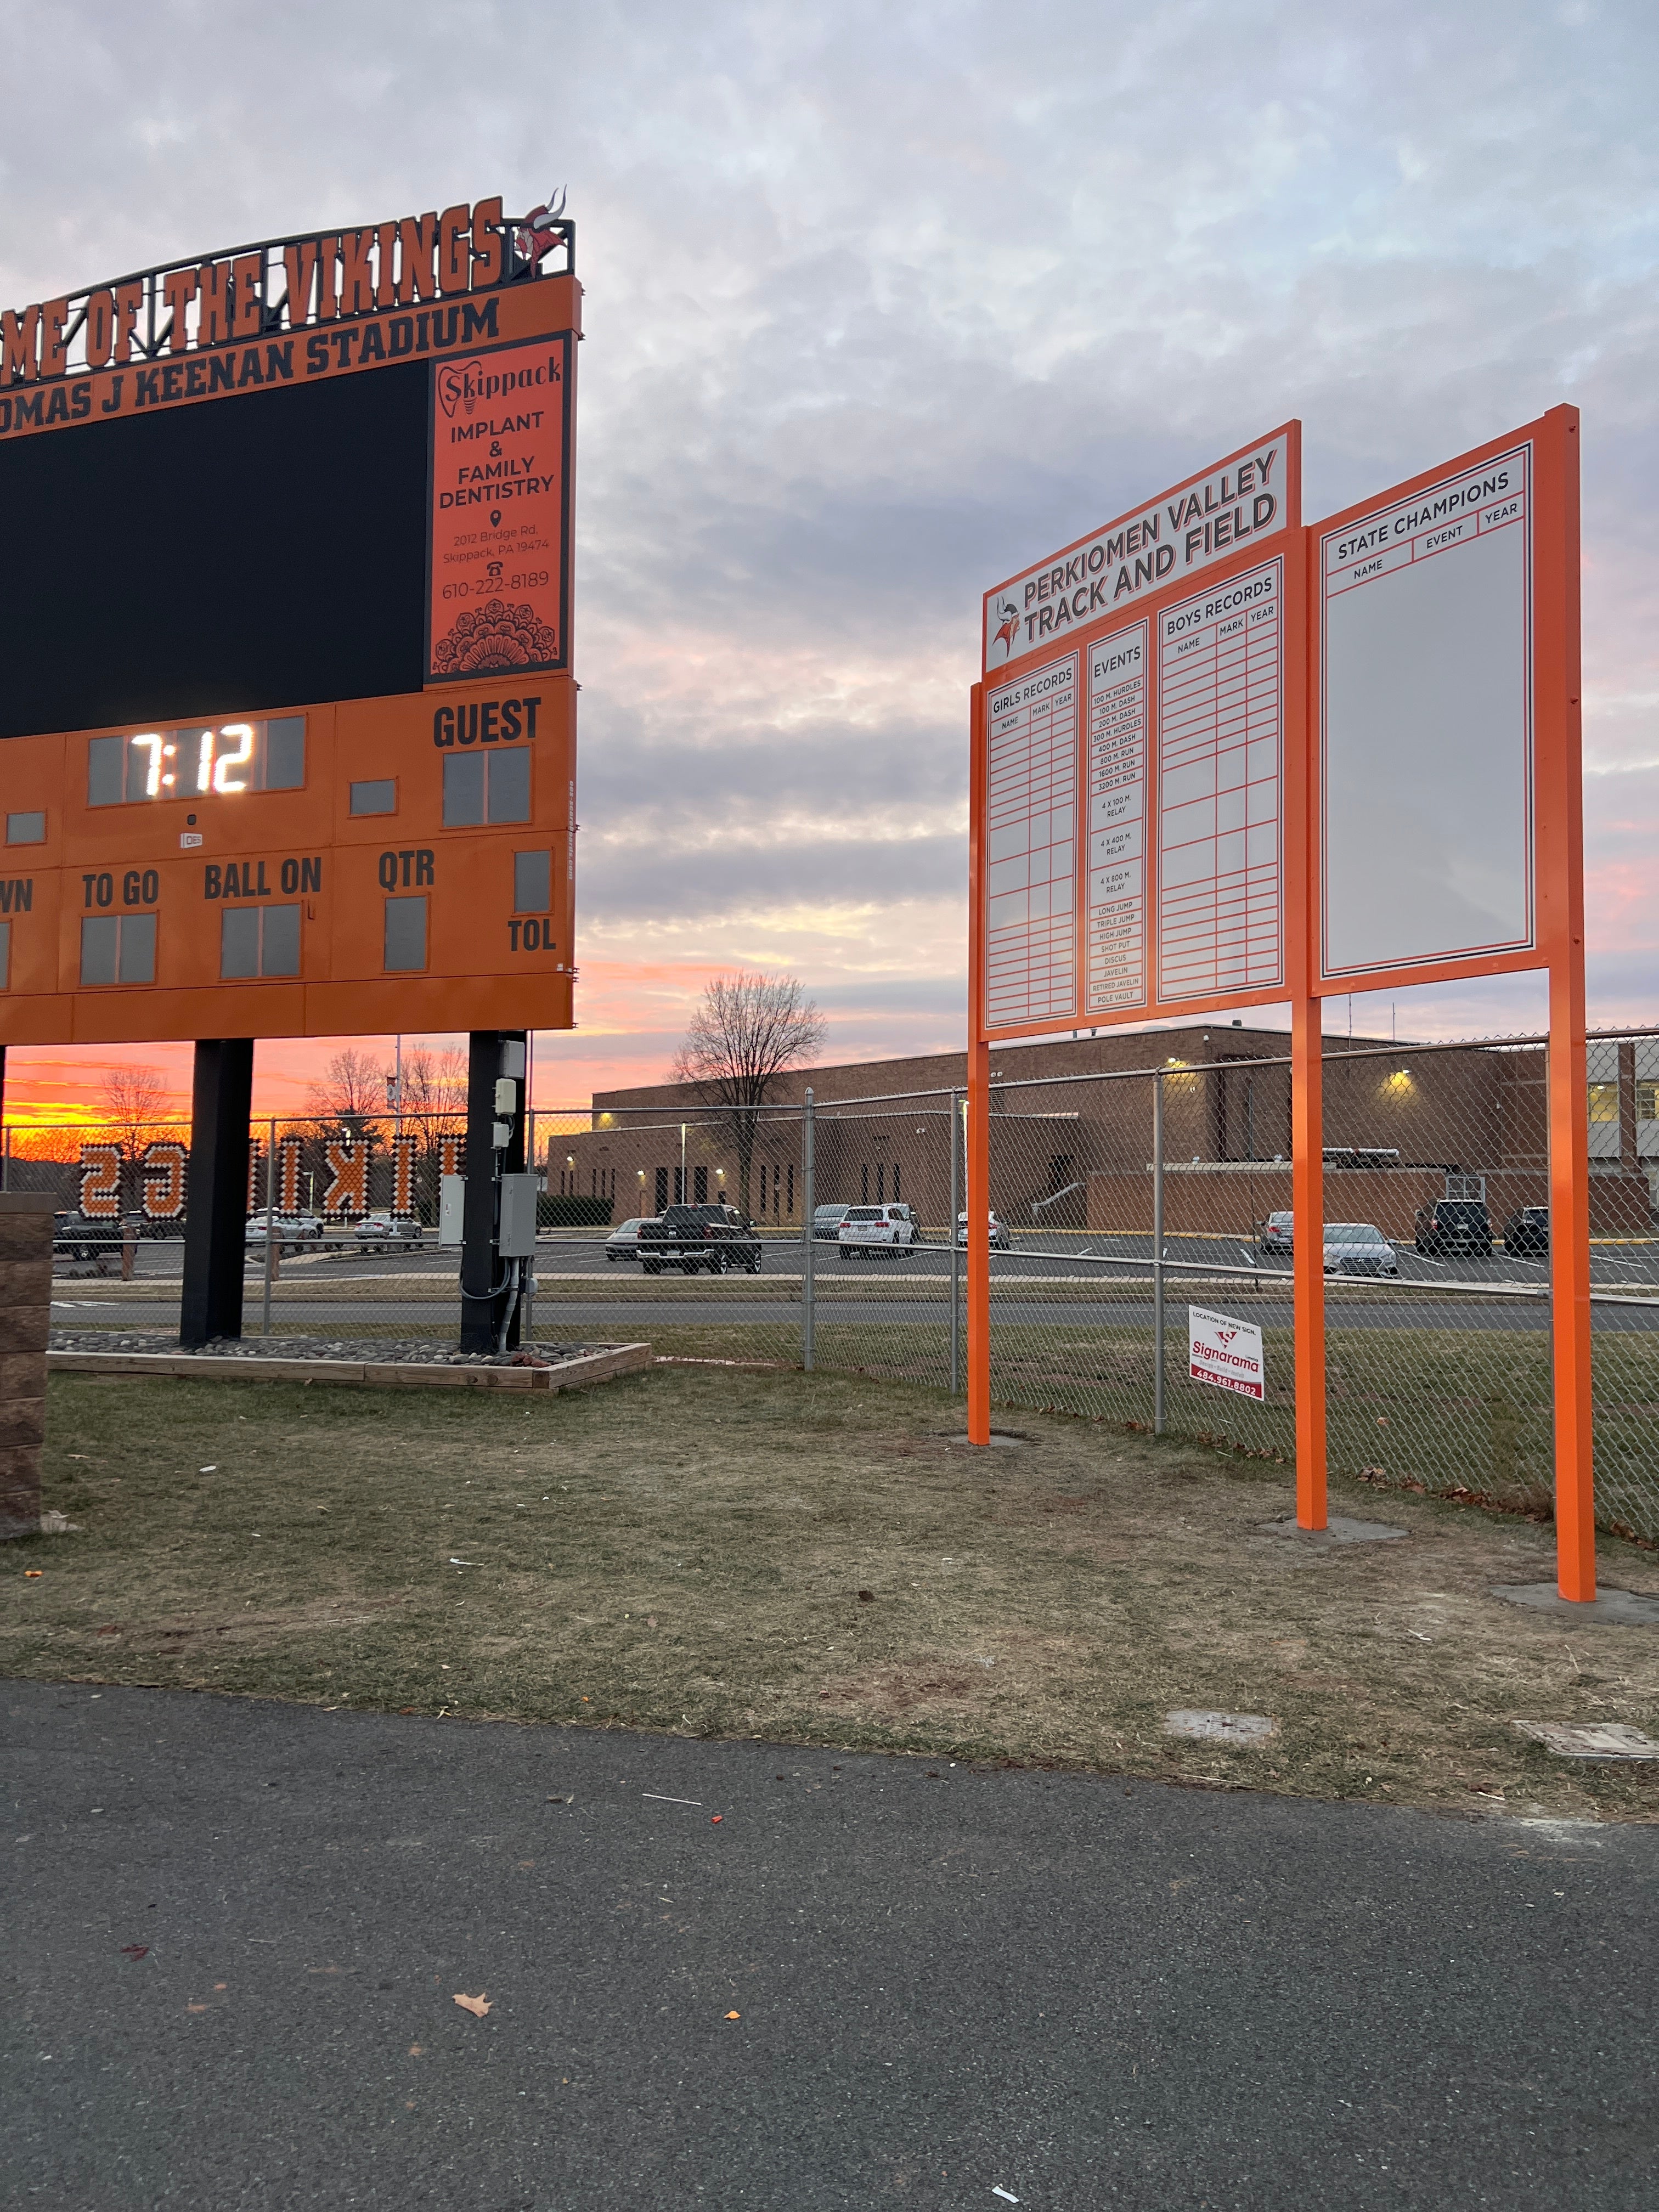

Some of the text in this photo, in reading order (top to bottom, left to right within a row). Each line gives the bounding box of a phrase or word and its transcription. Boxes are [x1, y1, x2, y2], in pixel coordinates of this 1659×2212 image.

[86, 280, 143, 368] OF
[164, 253, 262, 353] THE
[284, 195, 503, 327] VIKINGS
[101, 375, 125, 413] J
[135, 340, 295, 408] KEENAN
[306, 297, 499, 375] STADIUM
[445, 357, 561, 402] Skippack
[451, 411, 545, 443] IMPLANT
[489, 441, 503, 458] &
[458, 456, 534, 484] FAMILY
[439, 475, 555, 509] DENTISTRY
[1338, 472, 1509, 560] STATE CHAMPIONS
[454, 533, 477, 546] 2012
[480, 529, 517, 542] Bridge
[1024, 448, 1278, 610] PERKIOMEN VALLEY
[1353, 503, 1517, 579] NAME EVENT YEAR
[498, 545, 514, 555] PA
[516, 539, 549, 553] 19474
[1024, 493, 1277, 644] TRACK AND FIELD
[443, 571, 549, 600] 610-222-8189
[1167, 577, 1272, 635] BOYS RECORDS
[1177, 606, 1274, 653] NAME MARK YEAR
[1094, 646, 1141, 678] EVENTS
[994, 668, 1072, 713] GIRLS RECORDS
[1094, 695, 1104, 704] 100
[1113, 680, 1141, 697] HURDLES
[1002, 693, 1072, 730] NAME MARK YEAR
[1099, 706, 1109, 715] 100
[1119, 695, 1135, 707] DASH
[433, 697, 541, 747] GUEST
[1093, 732, 1104, 742] 300
[1114, 718, 1141, 735] HURDLES
[1099, 708, 1136, 728] 200 M. DASH
[1098, 744, 1110, 753] 400
[1120, 733, 1136, 745] DASH
[131, 724, 253, 797] 7:12
[1099, 768, 1113, 777] 1600
[1122, 759, 1135, 769] RUN
[1100, 755, 1111, 765] 800
[1121, 747, 1133, 757] RUN
[1099, 781, 1113, 791] 3200
[1122, 772, 1136, 782] RUN
[1107, 806, 1126, 817] RELAY
[1113, 797, 1123, 806] 100
[1125, 794, 1131, 802] M.
[1107, 844, 1125, 855] RELAY
[1111, 835, 1123, 844] 400
[204, 857, 322, 899] BALL ON
[379, 849, 435, 893] QTR
[1111, 873, 1122, 882] 800
[82, 870, 159, 908] TO GO
[1106, 883, 1125, 894] RELAY
[1098, 901, 1132, 915] LONG JUMP
[1097, 914, 1135, 928] TRIPLE JUMP
[507, 918, 556, 951] TOL
[1099, 927, 1131, 940] HIGH JUMP
[1101, 940, 1130, 952] SHOT PUT
[1105, 954, 1126, 964] DISCUS
[1104, 967, 1128, 978] JAVELIN
[1093, 978, 1139, 992] RETIRED JAVELIN
[1098, 991, 1133, 1004] POLE VAULT
[1193, 1311, 1219, 1324] LOCATION
[1228, 1322, 1241, 1330] NEW
[1193, 1341, 1259, 1373] Signarama
[1197, 1370, 1256, 1396] 484.961.8802
